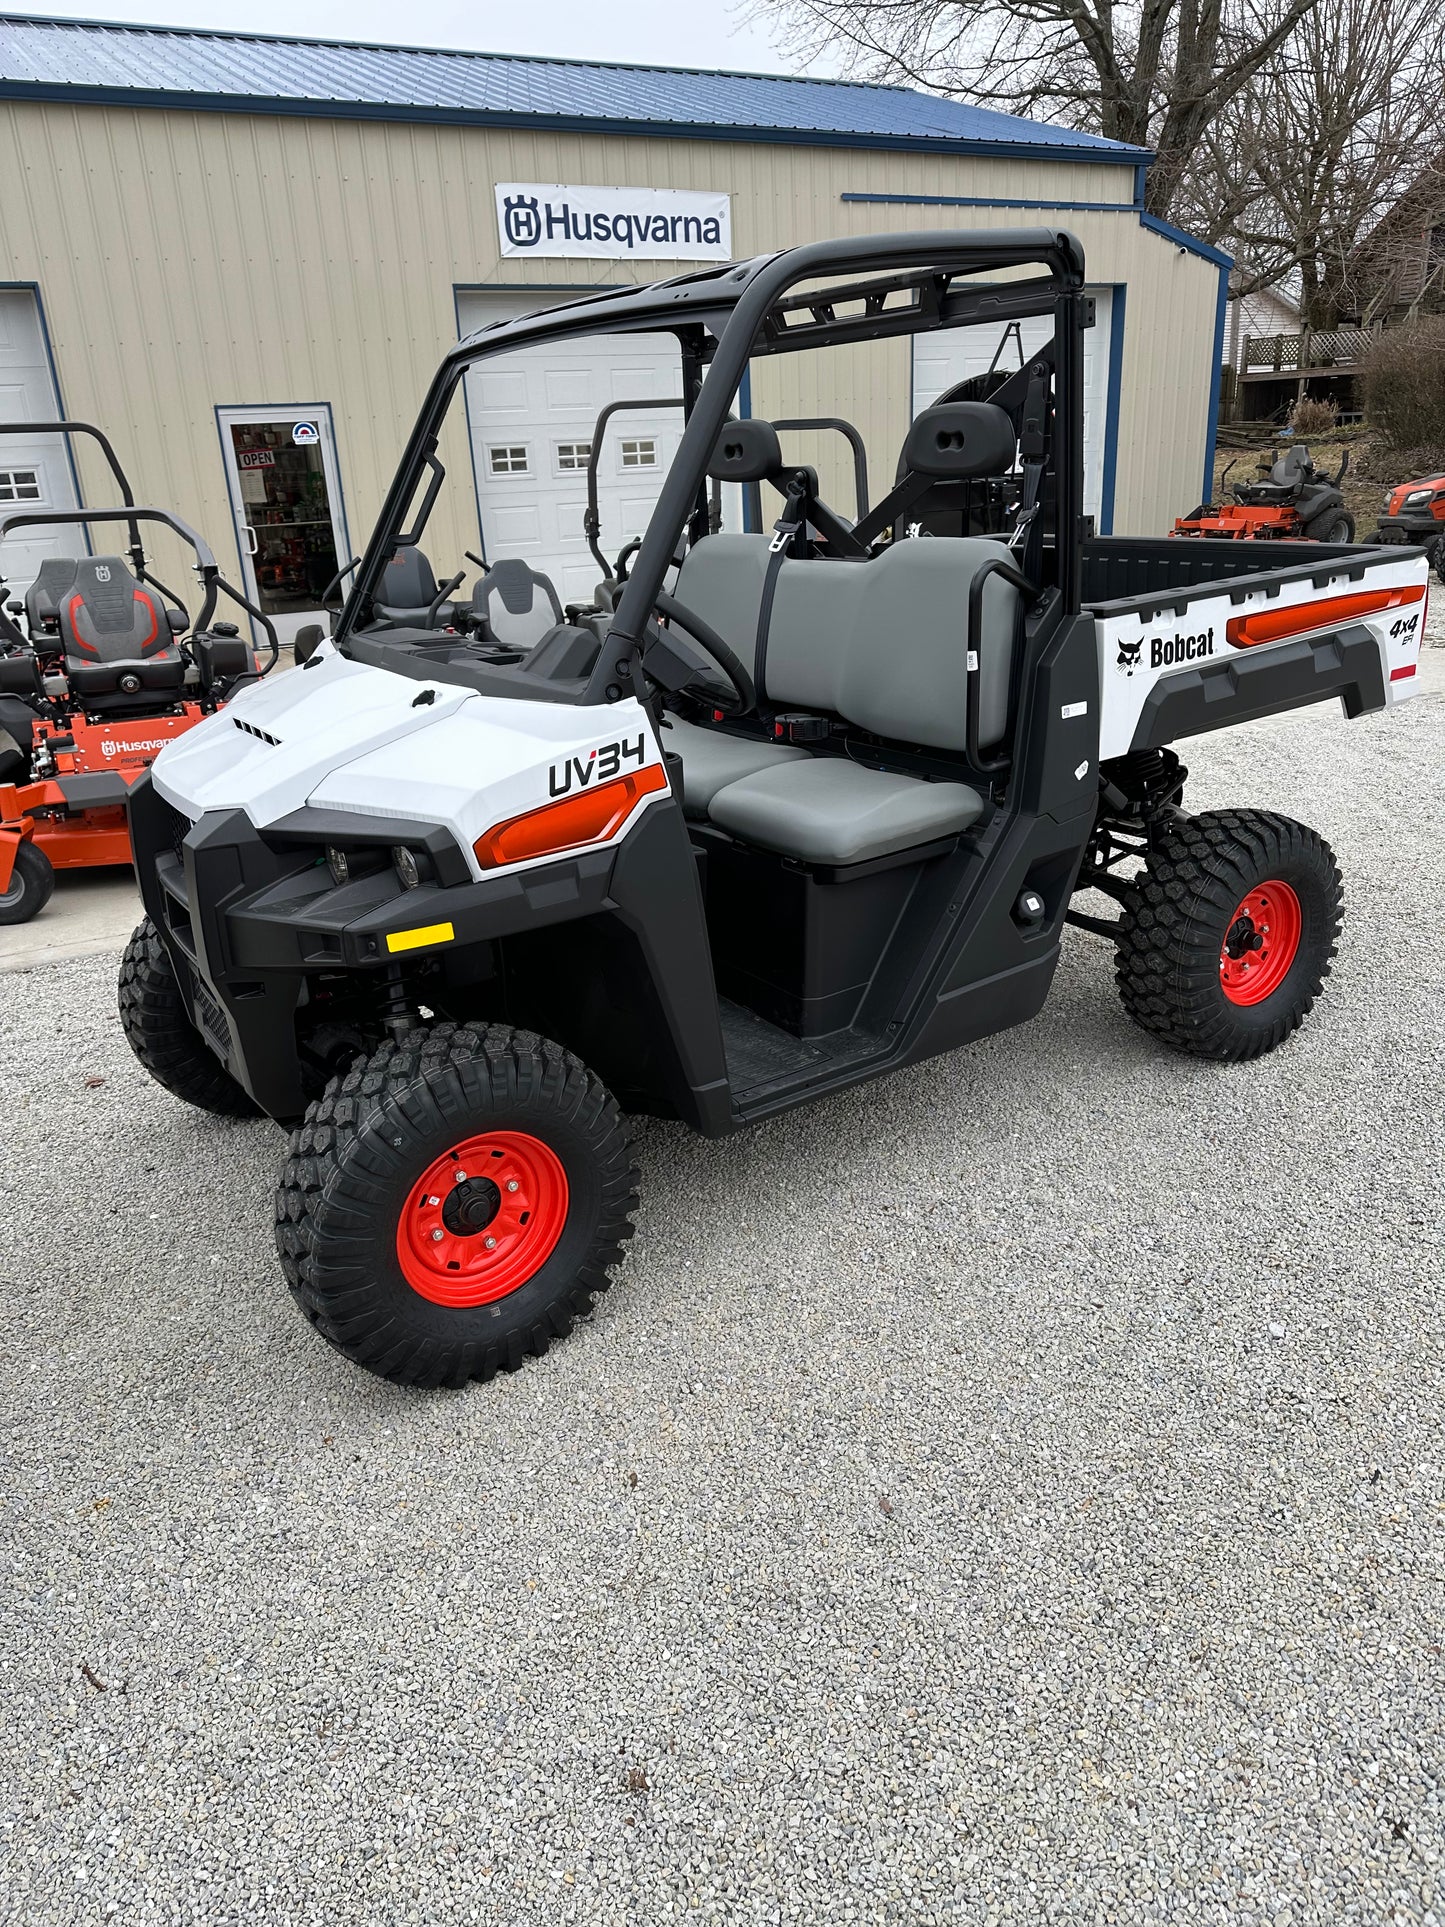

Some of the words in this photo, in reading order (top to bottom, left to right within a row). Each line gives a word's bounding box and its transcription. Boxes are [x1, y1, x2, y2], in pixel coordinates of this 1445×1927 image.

[544, 203, 721, 248] Husqvarna
[243, 451, 273, 466] OPEN
[1389, 613, 1420, 639] 4x4
[1150, 627, 1214, 668] Bobcat
[549, 732, 645, 798] UV34
